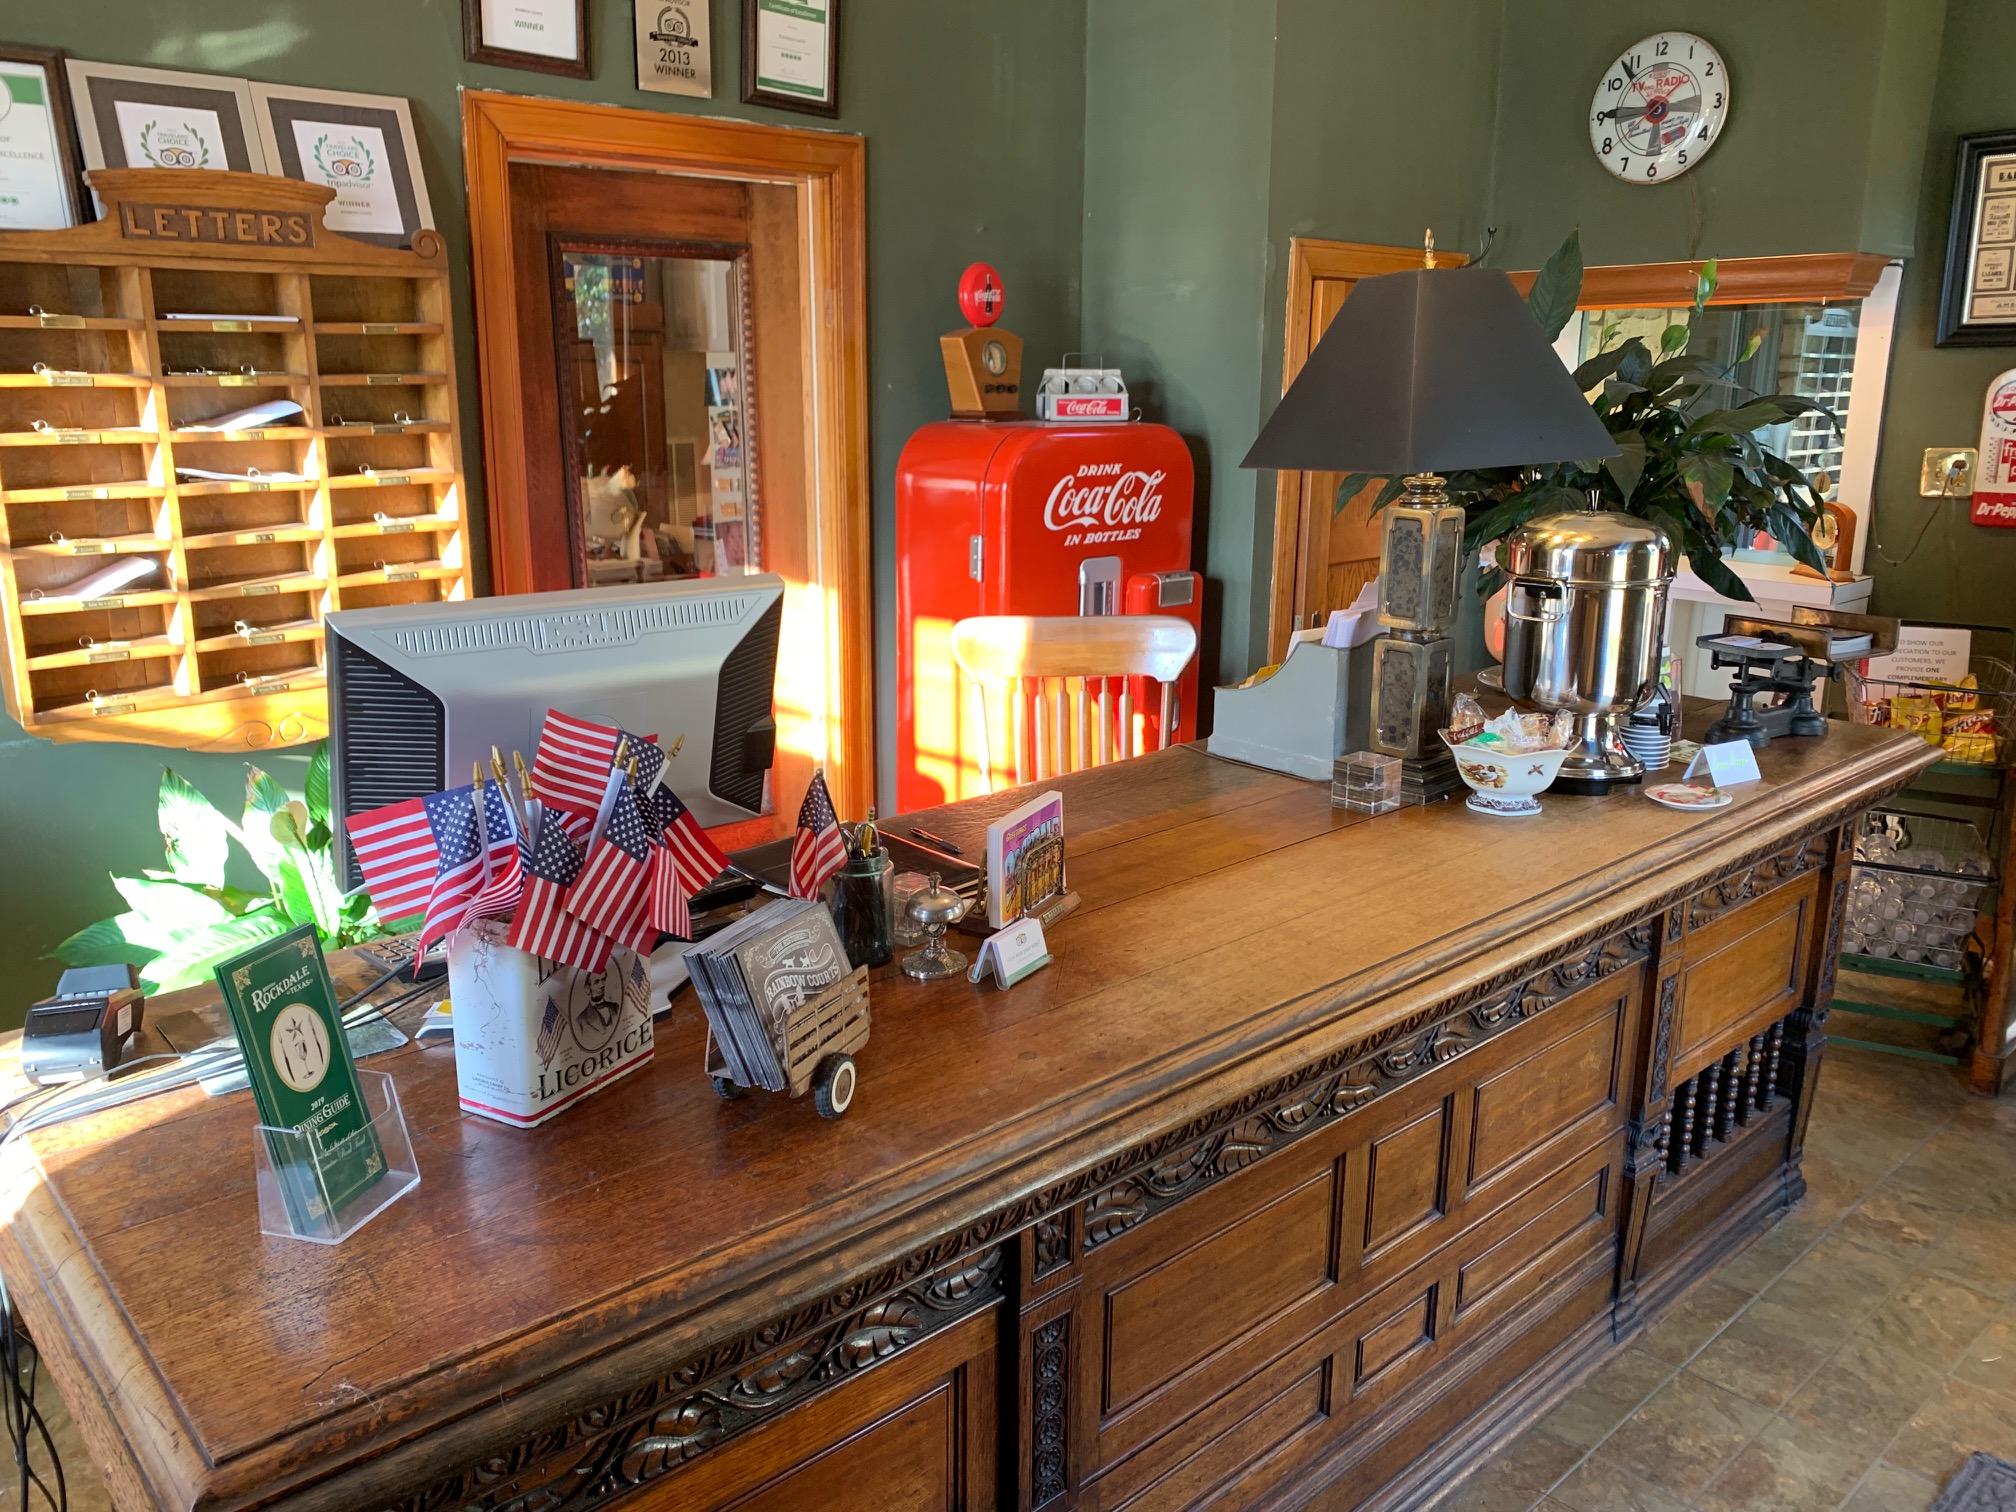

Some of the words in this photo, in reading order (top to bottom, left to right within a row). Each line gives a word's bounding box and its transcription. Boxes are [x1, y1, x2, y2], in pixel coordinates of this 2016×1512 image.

[513, 19, 544, 32] WINNER
[659, 48, 690, 65] 2013
[1655, 42, 1668, 56] 12
[1689, 45, 1694, 59] 1
[654, 63, 696, 79] WINNER
[1705, 62, 1714, 76] 2
[1607, 78, 1623, 92] 10
[1656, 74, 1690, 88] RADIO
[1713, 92, 1723, 109] 3
[1596, 111, 1606, 126] 9
[1697, 125, 1708, 141] 4
[158, 137, 189, 146] CHOICE
[1602, 137, 1612, 155] 8
[326, 149, 360, 159] CHOICE
[1678, 150, 1687, 164] 5
[1620, 157, 1629, 172] 7
[1646, 162, 1657, 177] 6
[338, 200, 371, 208] WINNER
[125, 206, 307, 244] LETTERS
[1066, 400, 1108, 415] Coca-Cola
[1077, 463, 1123, 477] DRINK
[1044, 469, 1167, 531] Coca-Cola
[1064, 534, 1082, 546] IN
[1083, 528, 1142, 545] BOTTLES
[1887, 674, 1948, 682] COMPLEMENTARY
[251, 965, 310, 1013] ROCKDALE
[290, 980, 310, 994] TEXAS
[766, 974, 806, 1002] RAINBOW
[807, 961, 839, 987] COURTS
[538, 1015, 653, 1101] LICORICE
[310, 1096, 325, 1111] 2019
[292, 1112, 323, 1141] DINING
[322, 1094, 351, 1117] GUIDE
